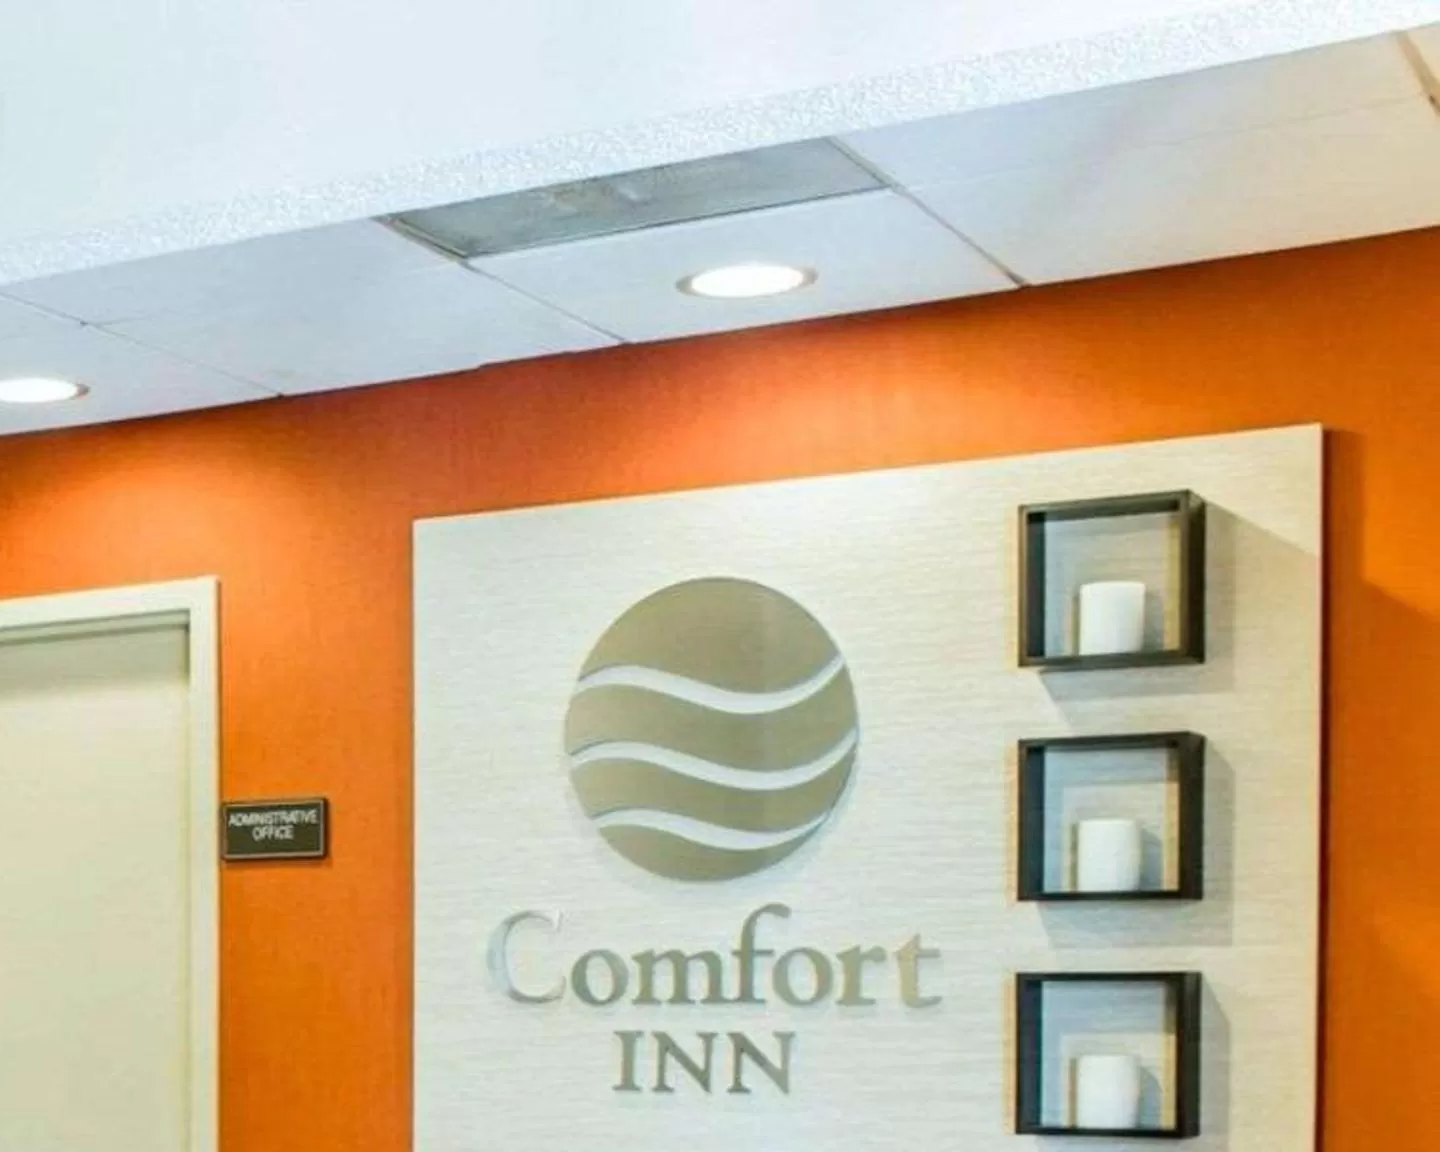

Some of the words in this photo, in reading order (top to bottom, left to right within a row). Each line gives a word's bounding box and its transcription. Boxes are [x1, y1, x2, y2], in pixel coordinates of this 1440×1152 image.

[228, 809, 317, 827] ADMINISTRATIVE
[252, 825, 294, 841] OFFICE
[487, 902, 943, 1009] Comfort
[612, 1030, 796, 1094] INN
